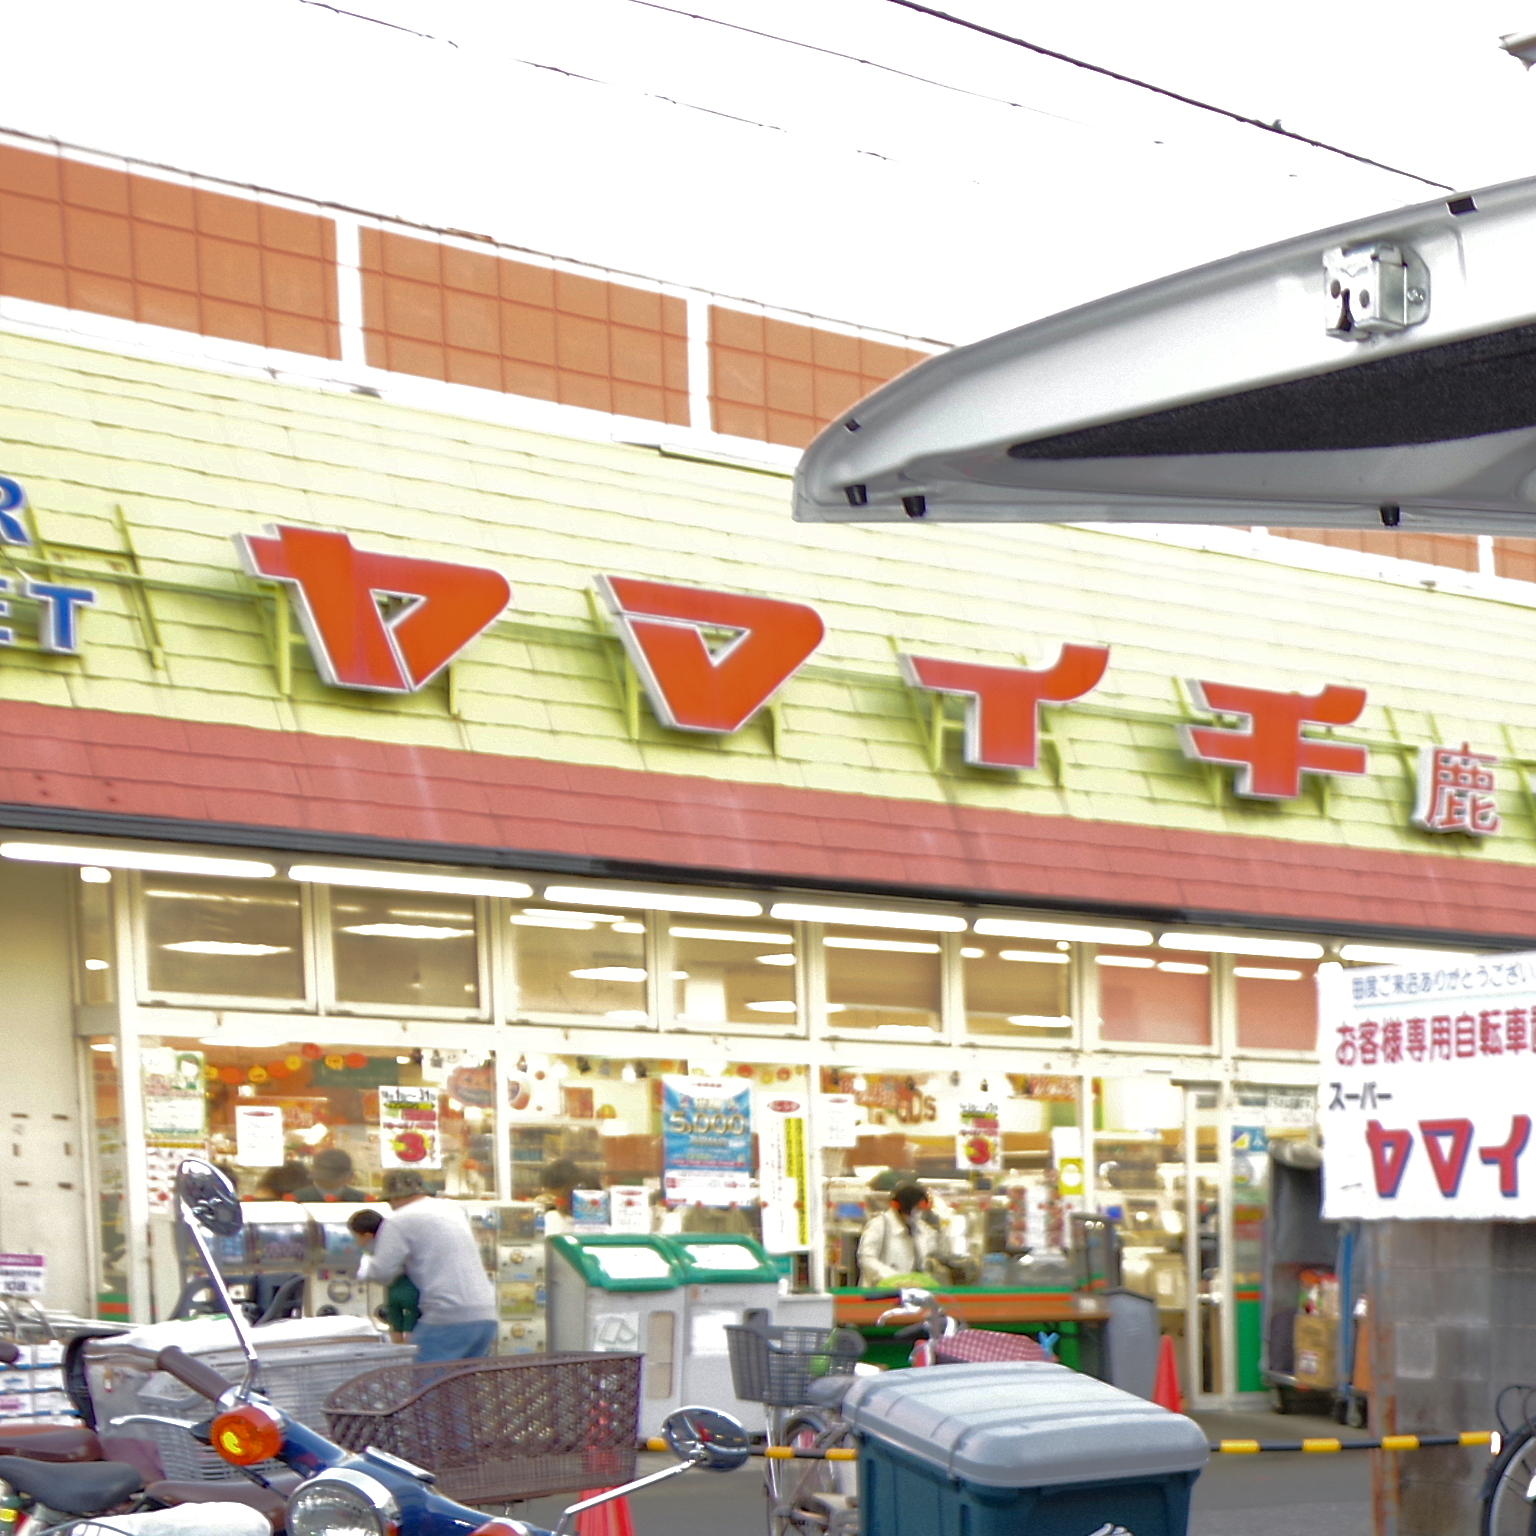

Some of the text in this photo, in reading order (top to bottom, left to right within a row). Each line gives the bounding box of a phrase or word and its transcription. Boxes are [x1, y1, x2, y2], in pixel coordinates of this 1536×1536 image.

[234, 523, 1368, 799] ヤマイチ
[1329, 1081, 1392, 1111] スーパー
